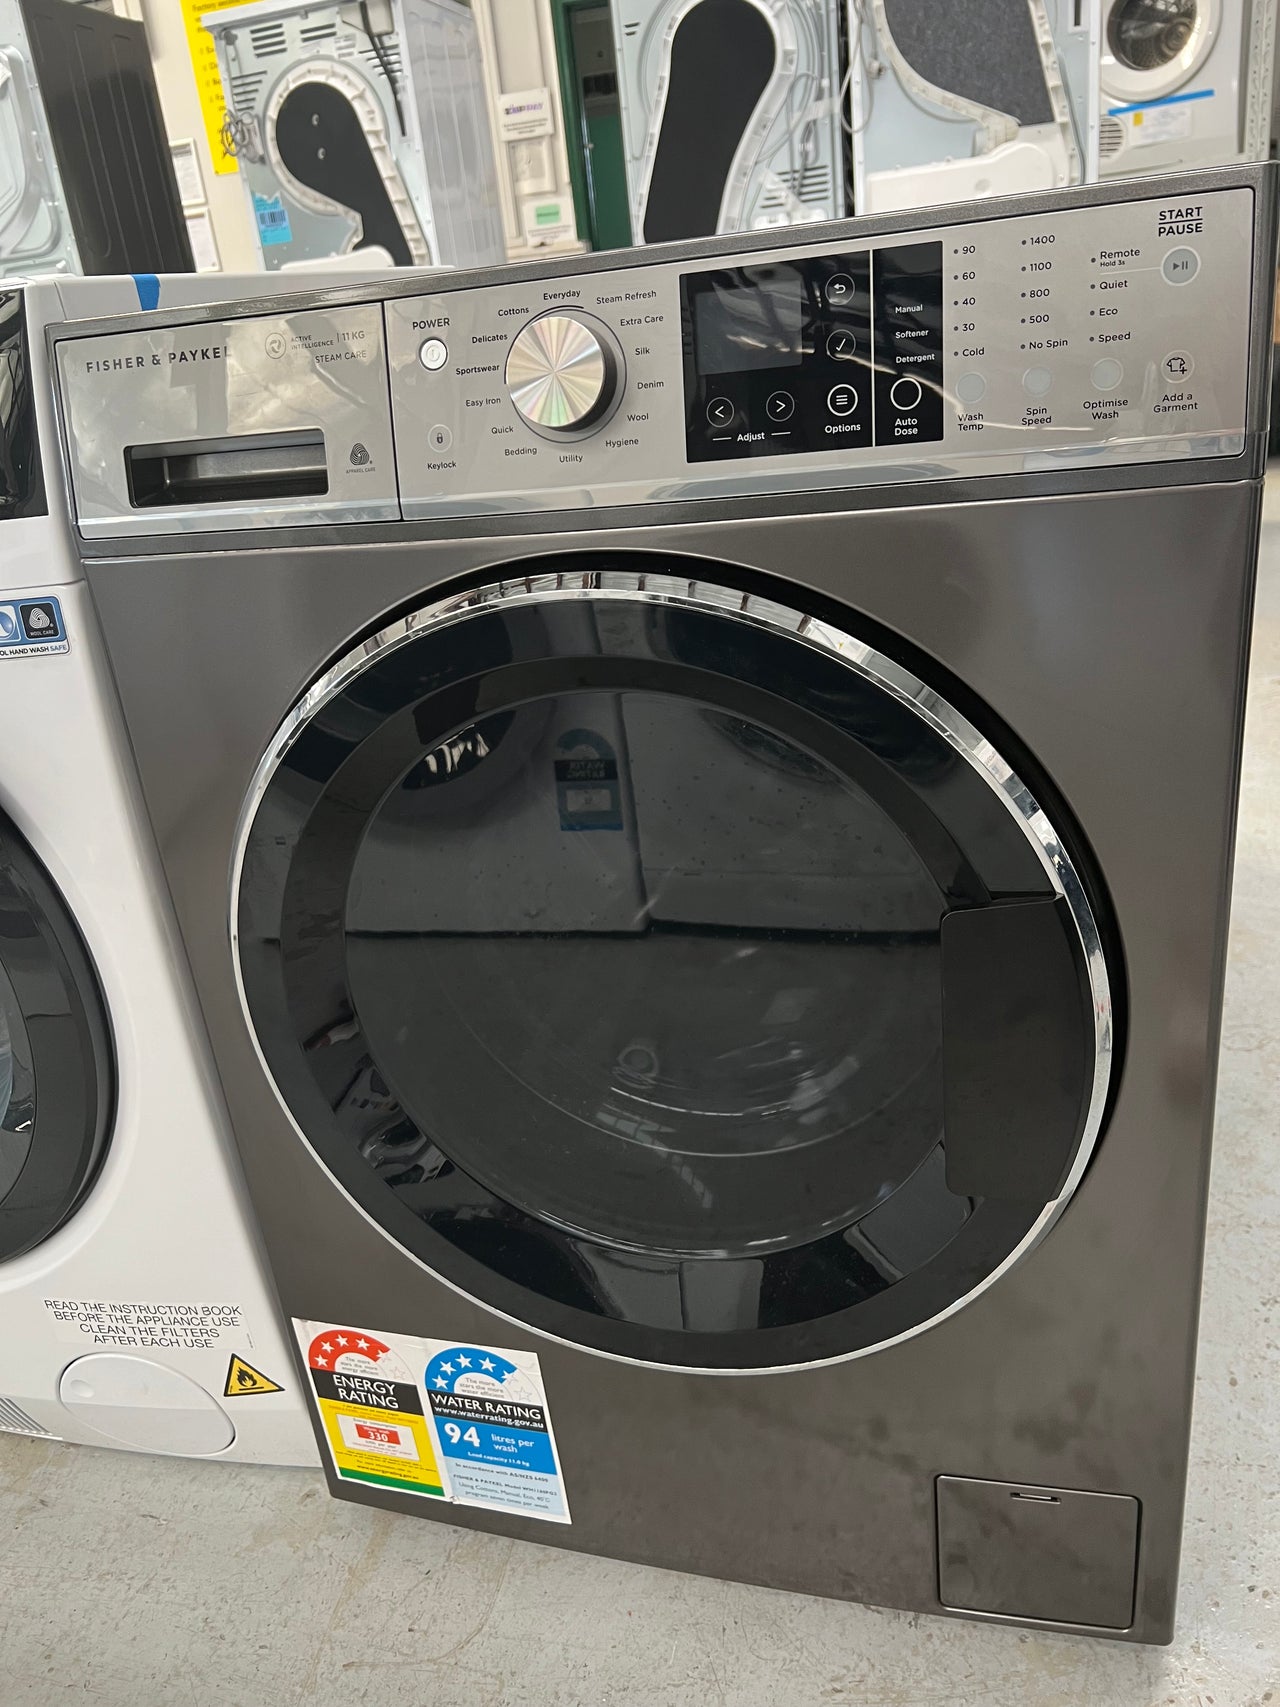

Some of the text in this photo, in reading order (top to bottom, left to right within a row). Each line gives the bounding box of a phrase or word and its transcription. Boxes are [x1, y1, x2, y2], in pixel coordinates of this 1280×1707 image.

[1158, 206, 1203, 221] START
[1158, 222, 1203, 237] PAUSE
[1029, 234, 1056, 246] 1400
[962, 245, 976, 255] 90
[1100, 247, 1141, 260] Remote
[1029, 261, 1052, 272] 1100
[1100, 259, 1126, 268] Hold 3s
[962, 271, 976, 281] 60
[1099, 279, 1129, 291] Quiet
[543, 289, 581, 301] Everyday
[596, 289, 657, 306] Steam Refresh
[1029, 288, 1050, 298] 800
[962, 297, 976, 306] 40
[497, 306, 530, 318] Cottons
[895, 304, 923, 314] Manual
[1099, 307, 1119, 317] Eco
[412, 317, 451, 331] POWER
[620, 314, 665, 327] Extra Care
[1029, 314, 1050, 324] 500
[962, 322, 976, 332] 30
[471, 332, 508, 344] Delicates
[895, 329, 929, 339] Softener
[1098, 332, 1131, 345] Speed
[291, 339, 335, 350] INTELLIGENCE
[1029, 338, 1069, 350] No Spin
[315, 350, 367, 364] STEAM CARE
[635, 347, 651, 356] Silk
[962, 347, 985, 357] Cold
[86, 356, 146, 373] FISHER
[151, 354, 161, 366] &
[895, 353, 935, 364] Detergent
[455, 364, 500, 376] Sportswear
[637, 379, 665, 390] Denim
[465, 396, 501, 409] Easy Iron
[1083, 397, 1129, 411] Optimise
[1162, 393, 1193, 403] Add a
[1026, 406, 1048, 418] Spin
[1153, 401, 1198, 414] Garment
[627, 412, 649, 422] Wool
[958, 412, 984, 422] Wash
[1021, 415, 1052, 427] Speed
[1091, 410, 1119, 421] Wash
[894, 417, 918, 427] Auto
[958, 421, 984, 432] Temp
[491, 425, 514, 436] Quick
[824, 423, 861, 434] Options
[894, 426, 918, 436] Dose
[605, 436, 639, 448] Hygiene
[737, 431, 765, 443] Adjust
[504, 446, 538, 458] Bedding
[427, 460, 457, 470] Keylock
[559, 454, 583, 465] Utility
[44, 1299, 243, 1317] READ THE INSTRUCTION BOOK
[54, 1311, 241, 1327] BEFORE THE APPLIANCE USE
[79, 1323, 220, 1338] CLEAN THE FILTERS
[93, 1335, 215, 1349] AFTER EACH USE
[332, 1374, 396, 1396] ENERGY
[338, 1388, 399, 1409] RATING
[431, 1393, 542, 1420] WATER RATING
[433, 1406, 544, 1429] www.waterrating.gov.au
[368, 1431, 389, 1442] 330
[444, 1422, 481, 1447] 94
[491, 1433, 535, 1448] litres per
[467, 1451, 483, 1459] Load
[493, 1444, 518, 1454] wash
